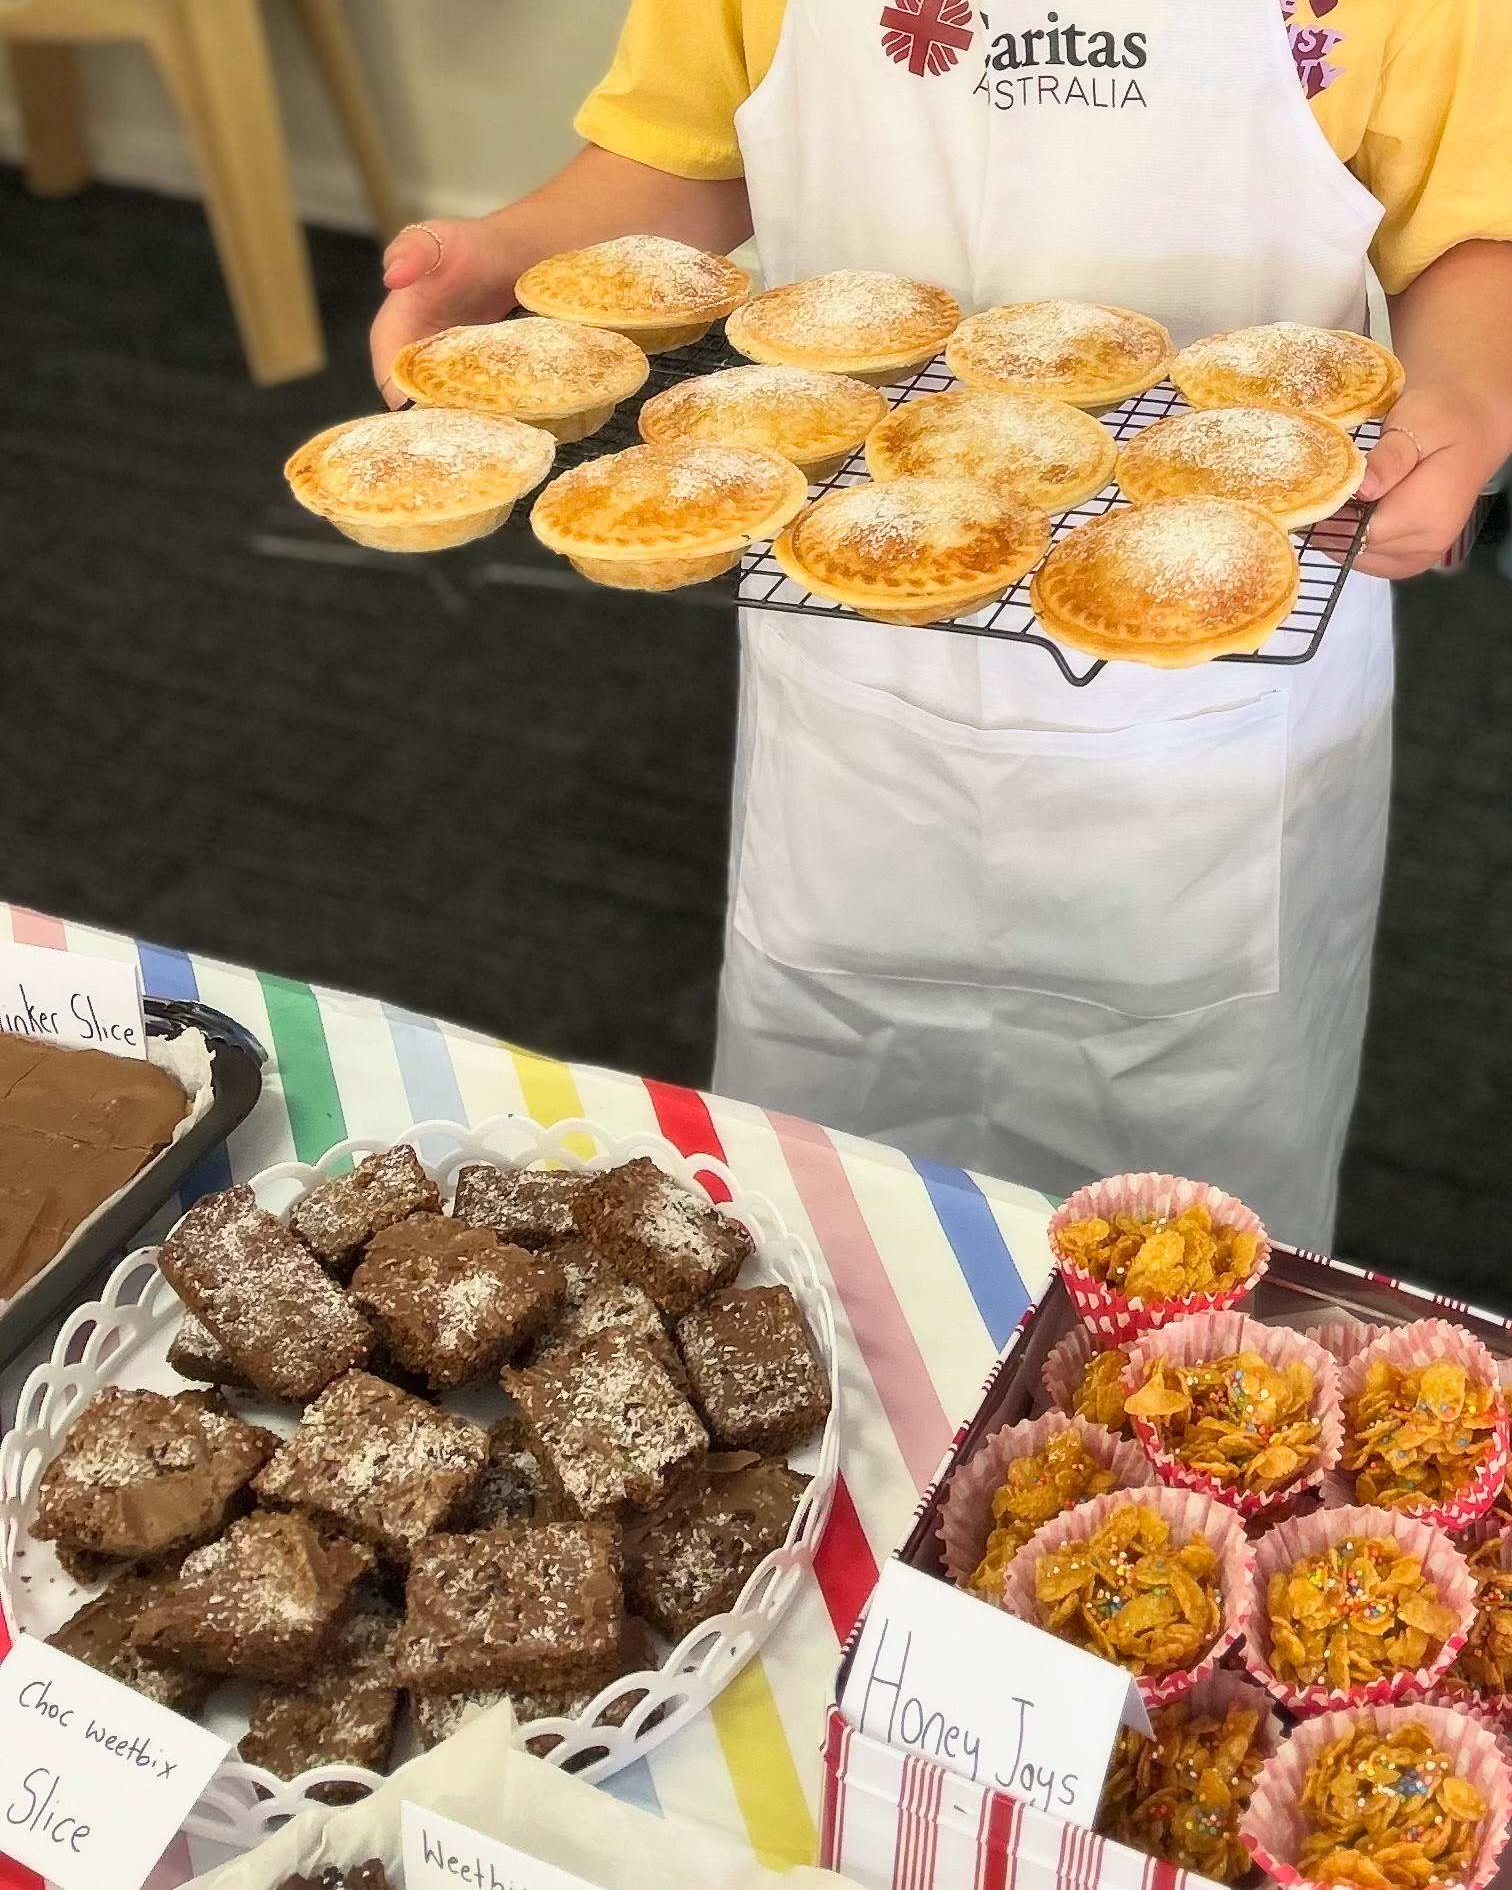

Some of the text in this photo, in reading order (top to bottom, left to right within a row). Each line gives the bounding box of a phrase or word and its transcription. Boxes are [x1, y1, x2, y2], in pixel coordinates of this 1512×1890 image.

[980, 11, 1148, 71] aritas
[70, 993, 137, 1046] Slice
[19, 1681, 75, 1728] Choc
[860, 1618, 981, 1781] Honey
[6, 1767, 91, 1853] Slice
